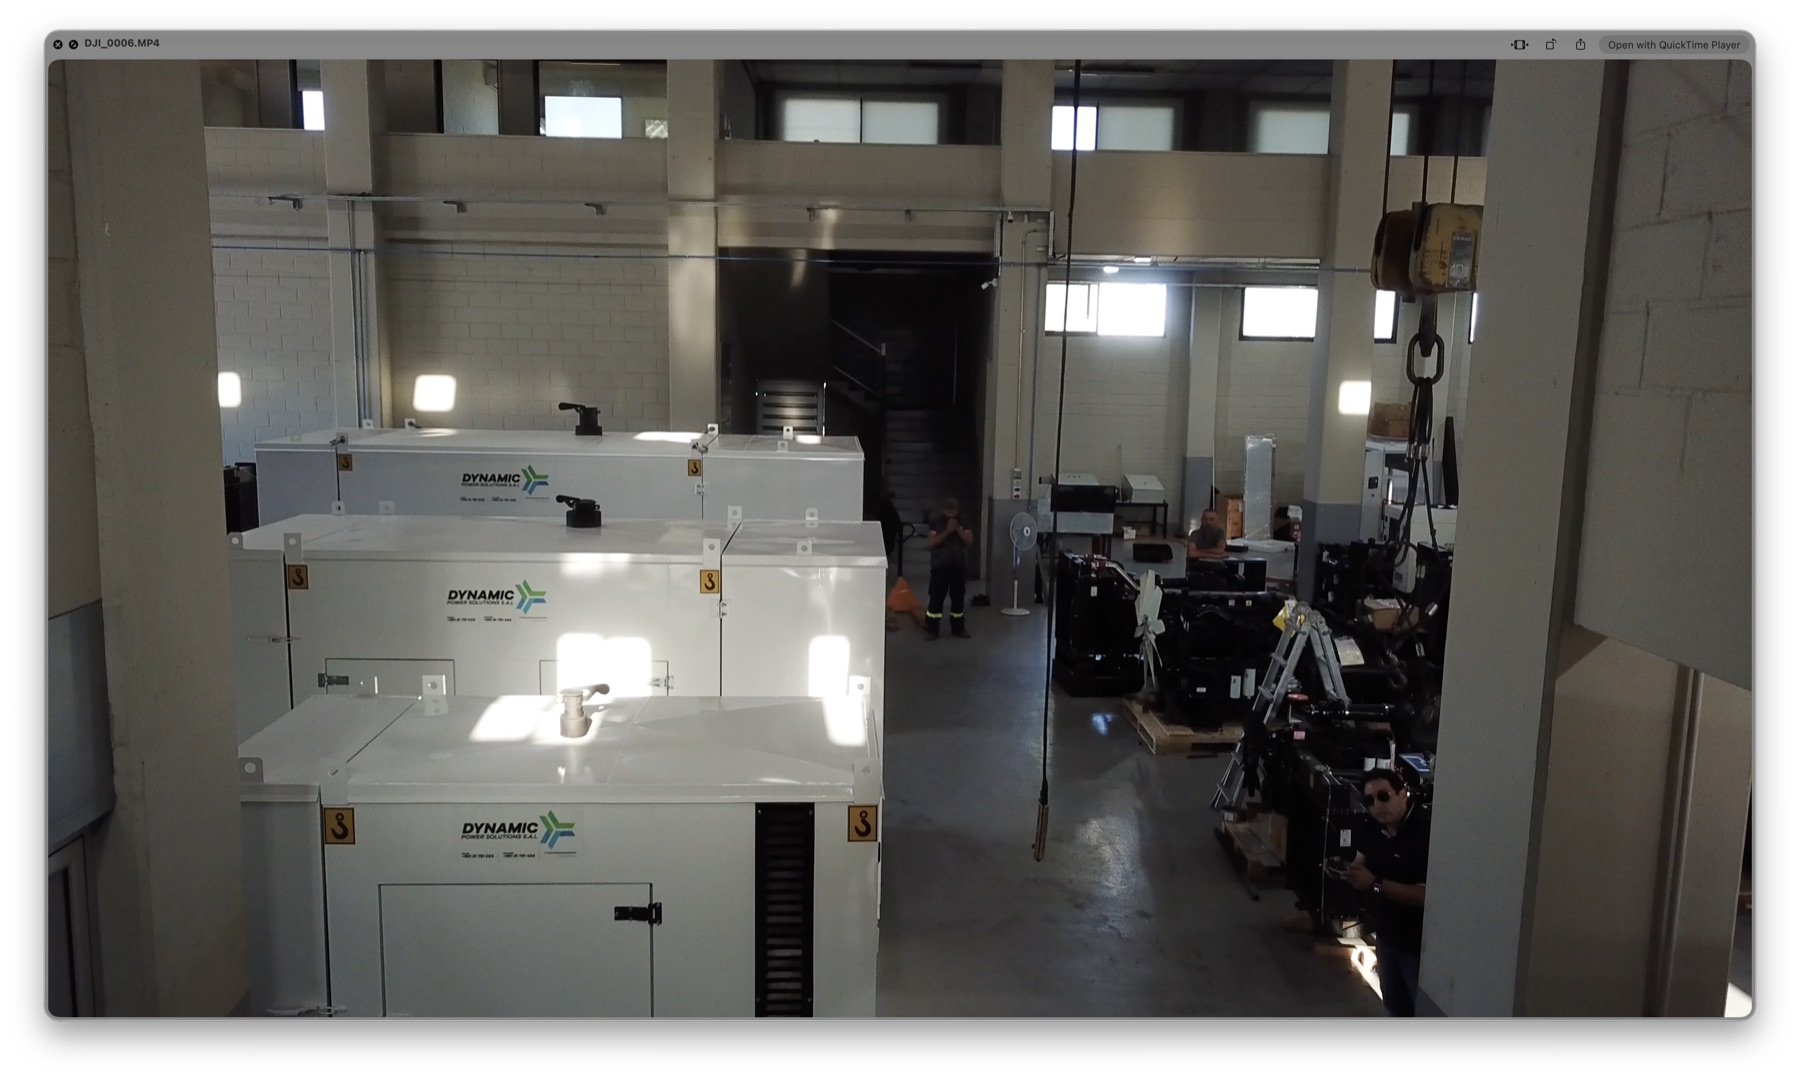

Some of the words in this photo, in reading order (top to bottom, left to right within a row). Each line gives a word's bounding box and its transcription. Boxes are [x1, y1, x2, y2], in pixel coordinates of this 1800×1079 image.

[462, 473, 521, 483] DYNAMIC
[448, 590, 515, 600] DYNAMIC
[462, 822, 539, 834] DYNAMIC
